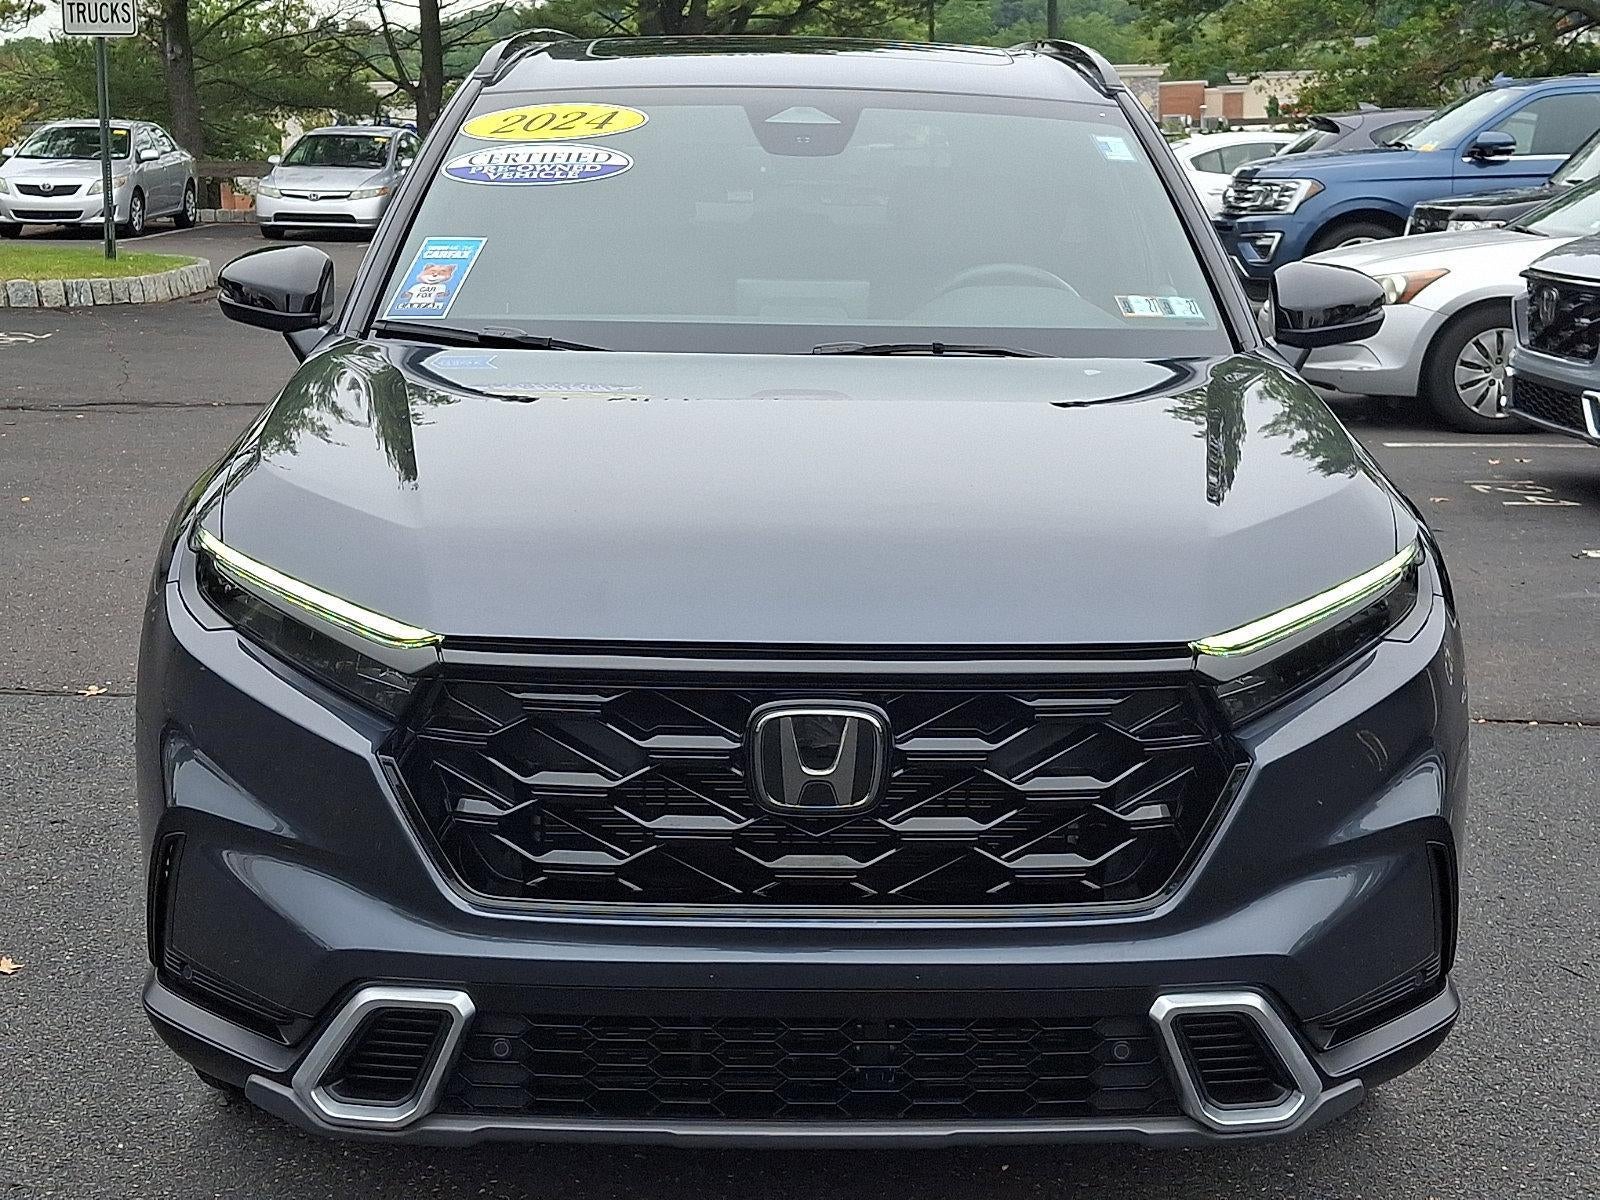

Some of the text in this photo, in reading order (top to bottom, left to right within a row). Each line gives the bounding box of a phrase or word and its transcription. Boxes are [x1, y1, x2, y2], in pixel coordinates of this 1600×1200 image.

[67, 2, 131, 23] TRUCKS
[489, 110, 620, 134] 2024
[468, 151, 612, 166] CERTIFIED
[469, 164, 602, 175] PRE-OWNED
[486, 171, 581, 181] VEHICLE
